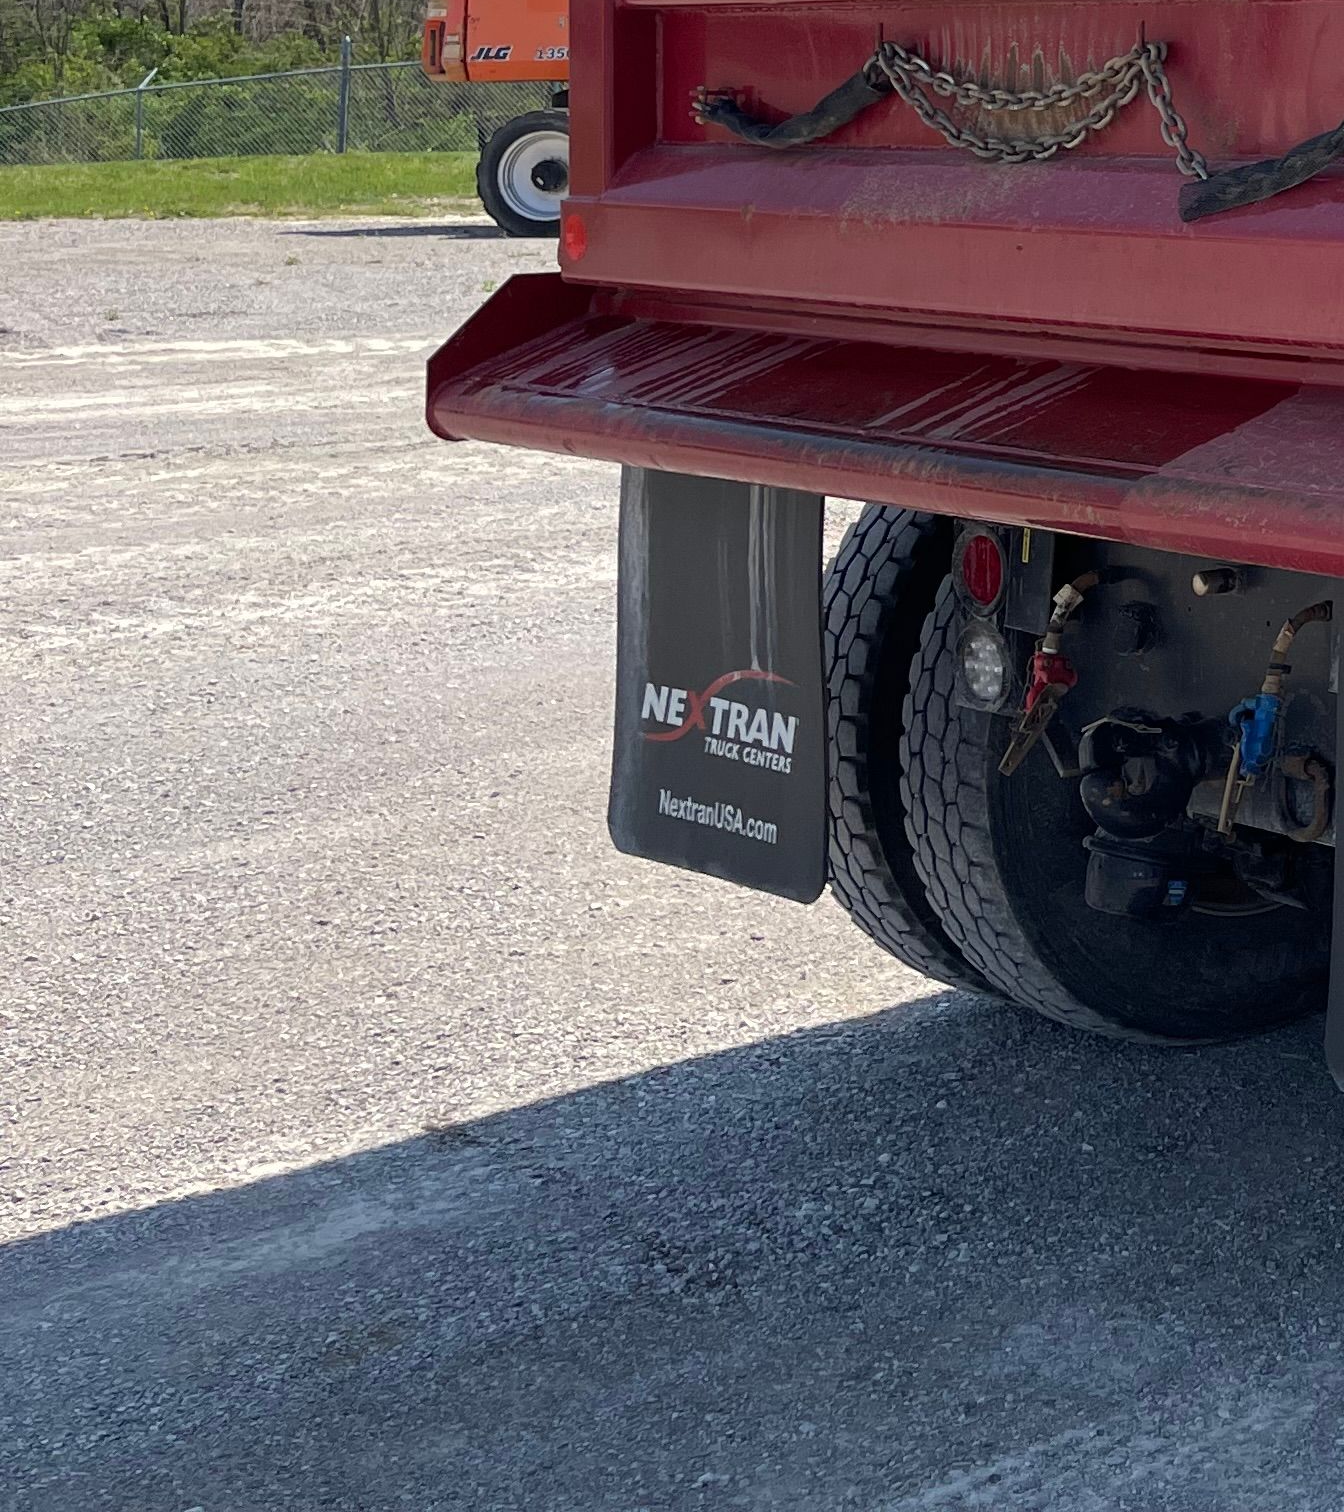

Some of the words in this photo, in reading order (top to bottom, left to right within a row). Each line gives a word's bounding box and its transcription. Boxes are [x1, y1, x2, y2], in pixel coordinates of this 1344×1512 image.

[470, 46, 512, 61] JLG
[536, 47, 570, 61] 135
[641, 682, 798, 754] NEXTRAN
[704, 736, 740, 762] TRUCK
[742, 746, 793, 775] CENTERS
[658, 788, 779, 846] NextranUSA.com
